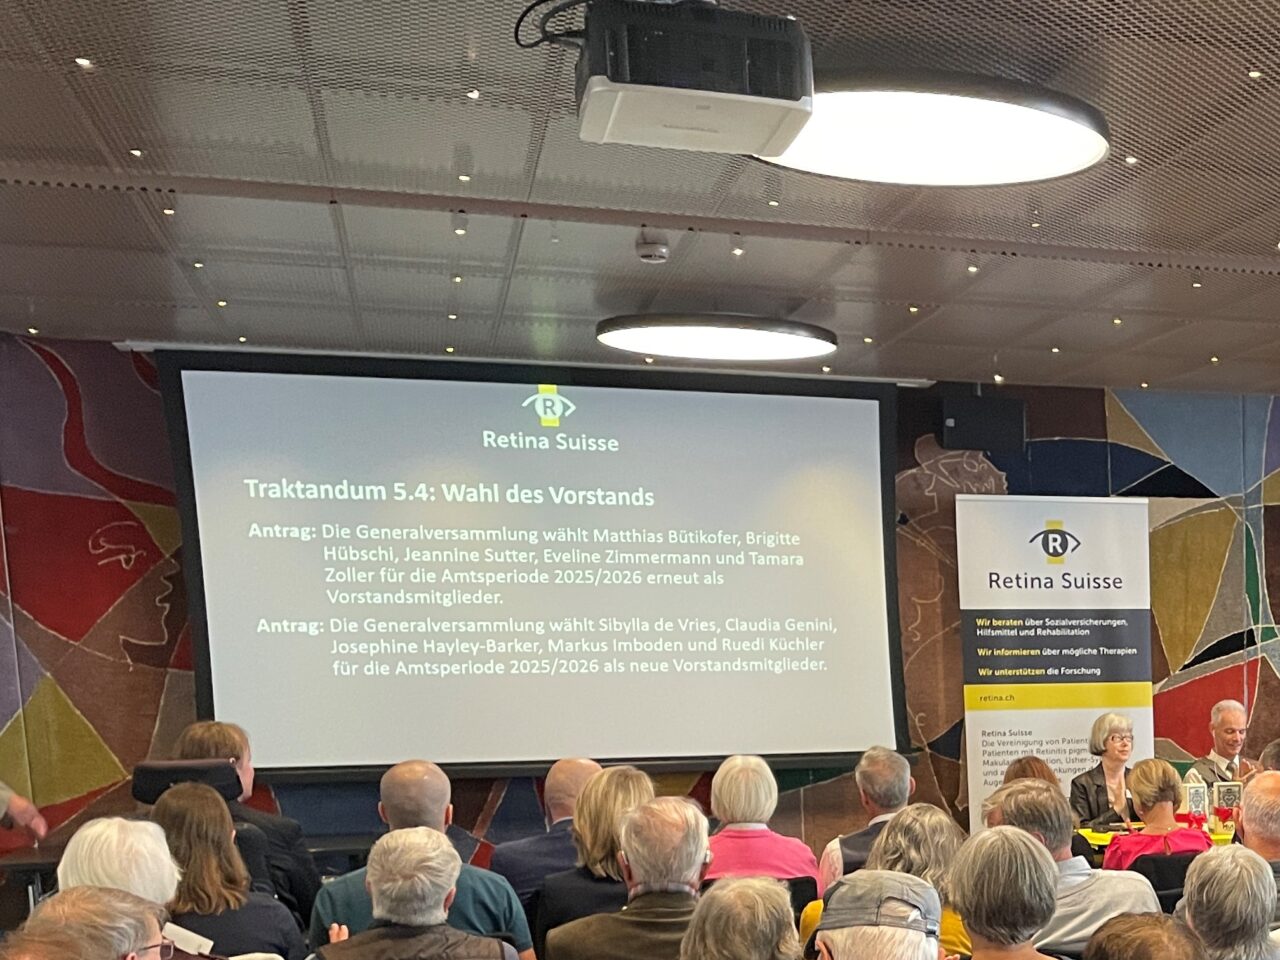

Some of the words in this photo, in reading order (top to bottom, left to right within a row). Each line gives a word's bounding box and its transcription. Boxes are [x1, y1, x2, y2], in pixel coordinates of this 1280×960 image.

[483, 431, 549, 449] Retina
[556, 433, 619, 452] Suisse
[244, 478, 386, 501] Traktandum
[394, 483, 436, 501] 5.4:
[441, 483, 499, 503] Wahl
[505, 484, 543, 504] des
[549, 486, 654, 506] Vorstands
[248, 523, 316, 541] Antrag:
[322, 524, 350, 539] Die
[356, 525, 538, 544] Generalversammlung
[543, 528, 588, 542] wählt
[594, 529, 663, 543] Matthias
[668, 530, 741, 547] Bütikofer,
[746, 532, 800, 548] Brigitte
[1048, 534, 1063, 553] R
[324, 546, 398, 564] Hübschi,
[403, 548, 479, 562] Jeannine
[484, 549, 538, 566] Sutter,
[544, 549, 601, 564] Eveline
[606, 550, 710, 564] Zimmermann
[716, 552, 744, 565] und
[749, 552, 804, 566] Tamara
[325, 568, 374, 583] Zoller
[380, 568, 404, 583] für
[410, 569, 436, 583] die
[441, 569, 549, 586] Amtsperiode
[554, 569, 641, 586] 2025/2026
[647, 572, 699, 584] erneut
[704, 571, 724, 584] als
[989, 572, 1053, 589] Retina
[1062, 572, 1122, 589] Suisse
[327, 589, 503, 607] Vorstandsmitglieder.
[257, 618, 324, 636] Antrag:
[330, 619, 358, 633] Die
[364, 618, 544, 634] Generalversammlung
[550, 618, 594, 632] wählt
[599, 618, 649, 634] Sibylla
[654, 618, 674, 632] de
[678, 618, 720, 634] Vries,
[725, 618, 780, 632] Claudia
[785, 618, 837, 633] Genini,
[976, 618, 991, 626] Wir
[993, 618, 1023, 626] beraten
[1025, 618, 1043, 626] über
[1045, 618, 1128, 627] Sozialversicherungen,
[330, 640, 418, 656] Josephine
[424, 639, 542, 656] Hayley-Barker,
[548, 639, 608, 652] Markus
[613, 638, 682, 652] Imboden
[688, 638, 716, 651] und
[722, 638, 764, 651] Ruedi
[769, 638, 824, 651] Küchler
[994, 648, 1040, 656] informieren
[1042, 648, 1060, 656] über
[1062, 648, 1097, 656] mögliche
[1099, 647, 1137, 656] Therapien
[333, 661, 358, 675] für
[364, 660, 389, 675] die
[395, 660, 504, 677] Amtsperiode
[510, 659, 599, 676] 2025/2026
[604, 659, 624, 672] als
[630, 661, 669, 672] neue
[673, 657, 827, 674] Vorstandsmitglieder.
[995, 668, 1045, 676] unterstützen
[1061, 667, 1101, 676] Forschung
[998, 739, 1043, 747] Vereinigung
[984, 779, 1002, 787] Auge
